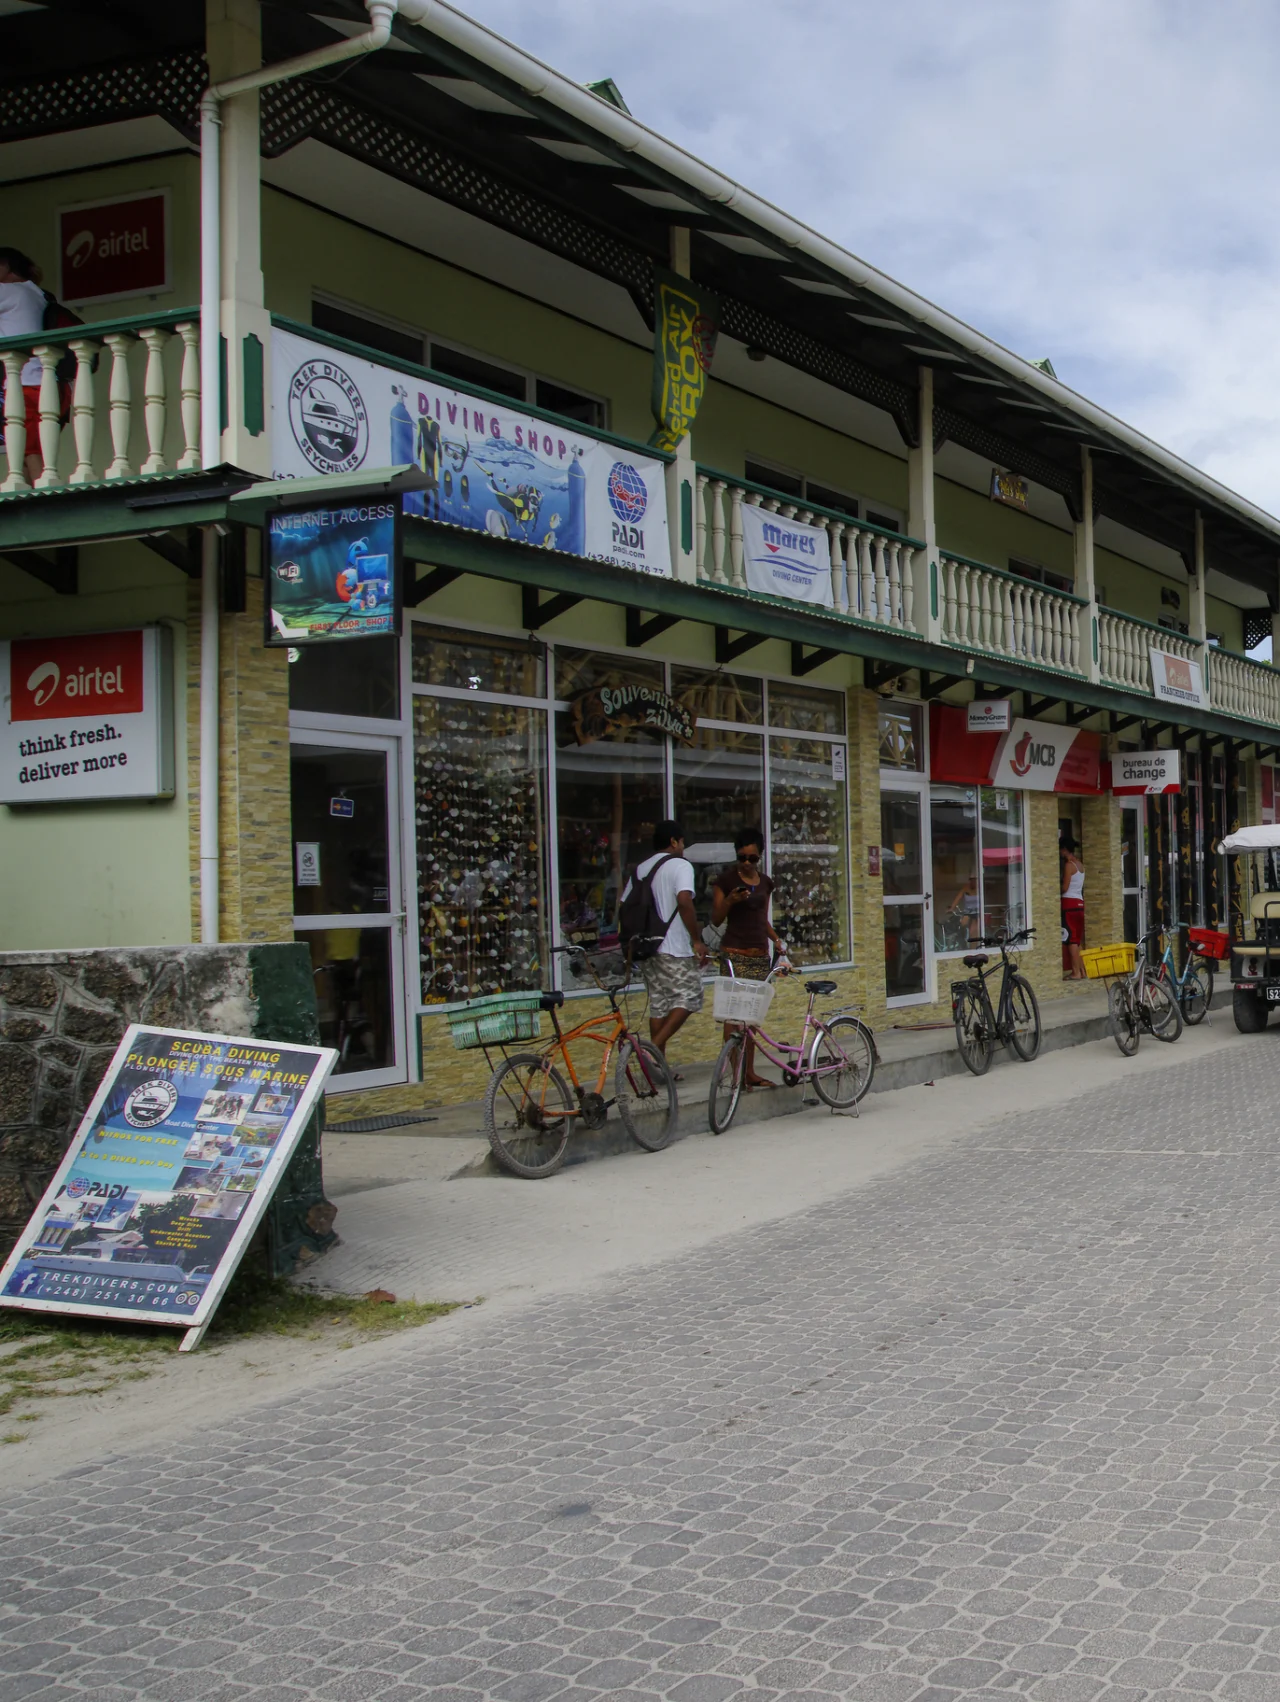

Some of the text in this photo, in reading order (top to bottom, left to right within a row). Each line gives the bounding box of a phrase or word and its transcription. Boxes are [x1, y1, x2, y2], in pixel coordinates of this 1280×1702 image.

[98, 226, 149, 258] airtel
[292, 364, 365, 422] TREK DIVERS
[417, 392, 567, 460] DIVING SHOP
[301, 438, 359, 473] SEYCHELLES
[272, 504, 395, 531] INTERNET ACCESS
[611, 521, 645, 551] PADI
[762, 522, 816, 556] mares
[612, 545, 645, 559] padi.com
[772, 569, 813, 585] DIVING CENTER
[309, 622, 331, 631] FIRST
[333, 619, 360, 629] FLOOR
[366, 617, 388, 627] SHOP
[64, 665, 124, 697] airtel
[969, 714, 1007, 722] MoneyGram
[19, 723, 122, 757] think fresh.
[1029, 742, 1056, 767] MCB
[1122, 757, 1166, 768] bureau de
[19, 752, 128, 783] deliver more
[1123, 767, 1166, 781] change
[168, 1050, 193, 1058] DIVING
[252, 1060, 277, 1068] TRACK
[171, 1041, 281, 1063] SCUBA DIVING
[203, 1062, 245, 1077] SOUS
[250, 1068, 310, 1085] MARINE
[130, 1080, 177, 1103] TREK DIVERS
[269, 1081, 306, 1090] BATTUS
[181, 1120, 197, 1128] Dive
[196, 1123, 219, 1131] Center
[134, 1134, 152, 1143] FOR
[155, 1137, 179, 1147] FREE
[110, 1155, 137, 1164] DIVES
[157, 1160, 175, 1169] Day
[86, 1181, 129, 1199] PADI
[42, 1271, 179, 1294] TREKDIVERS.COM
[36, 1284, 169, 1306] (+248) 251 30 66
